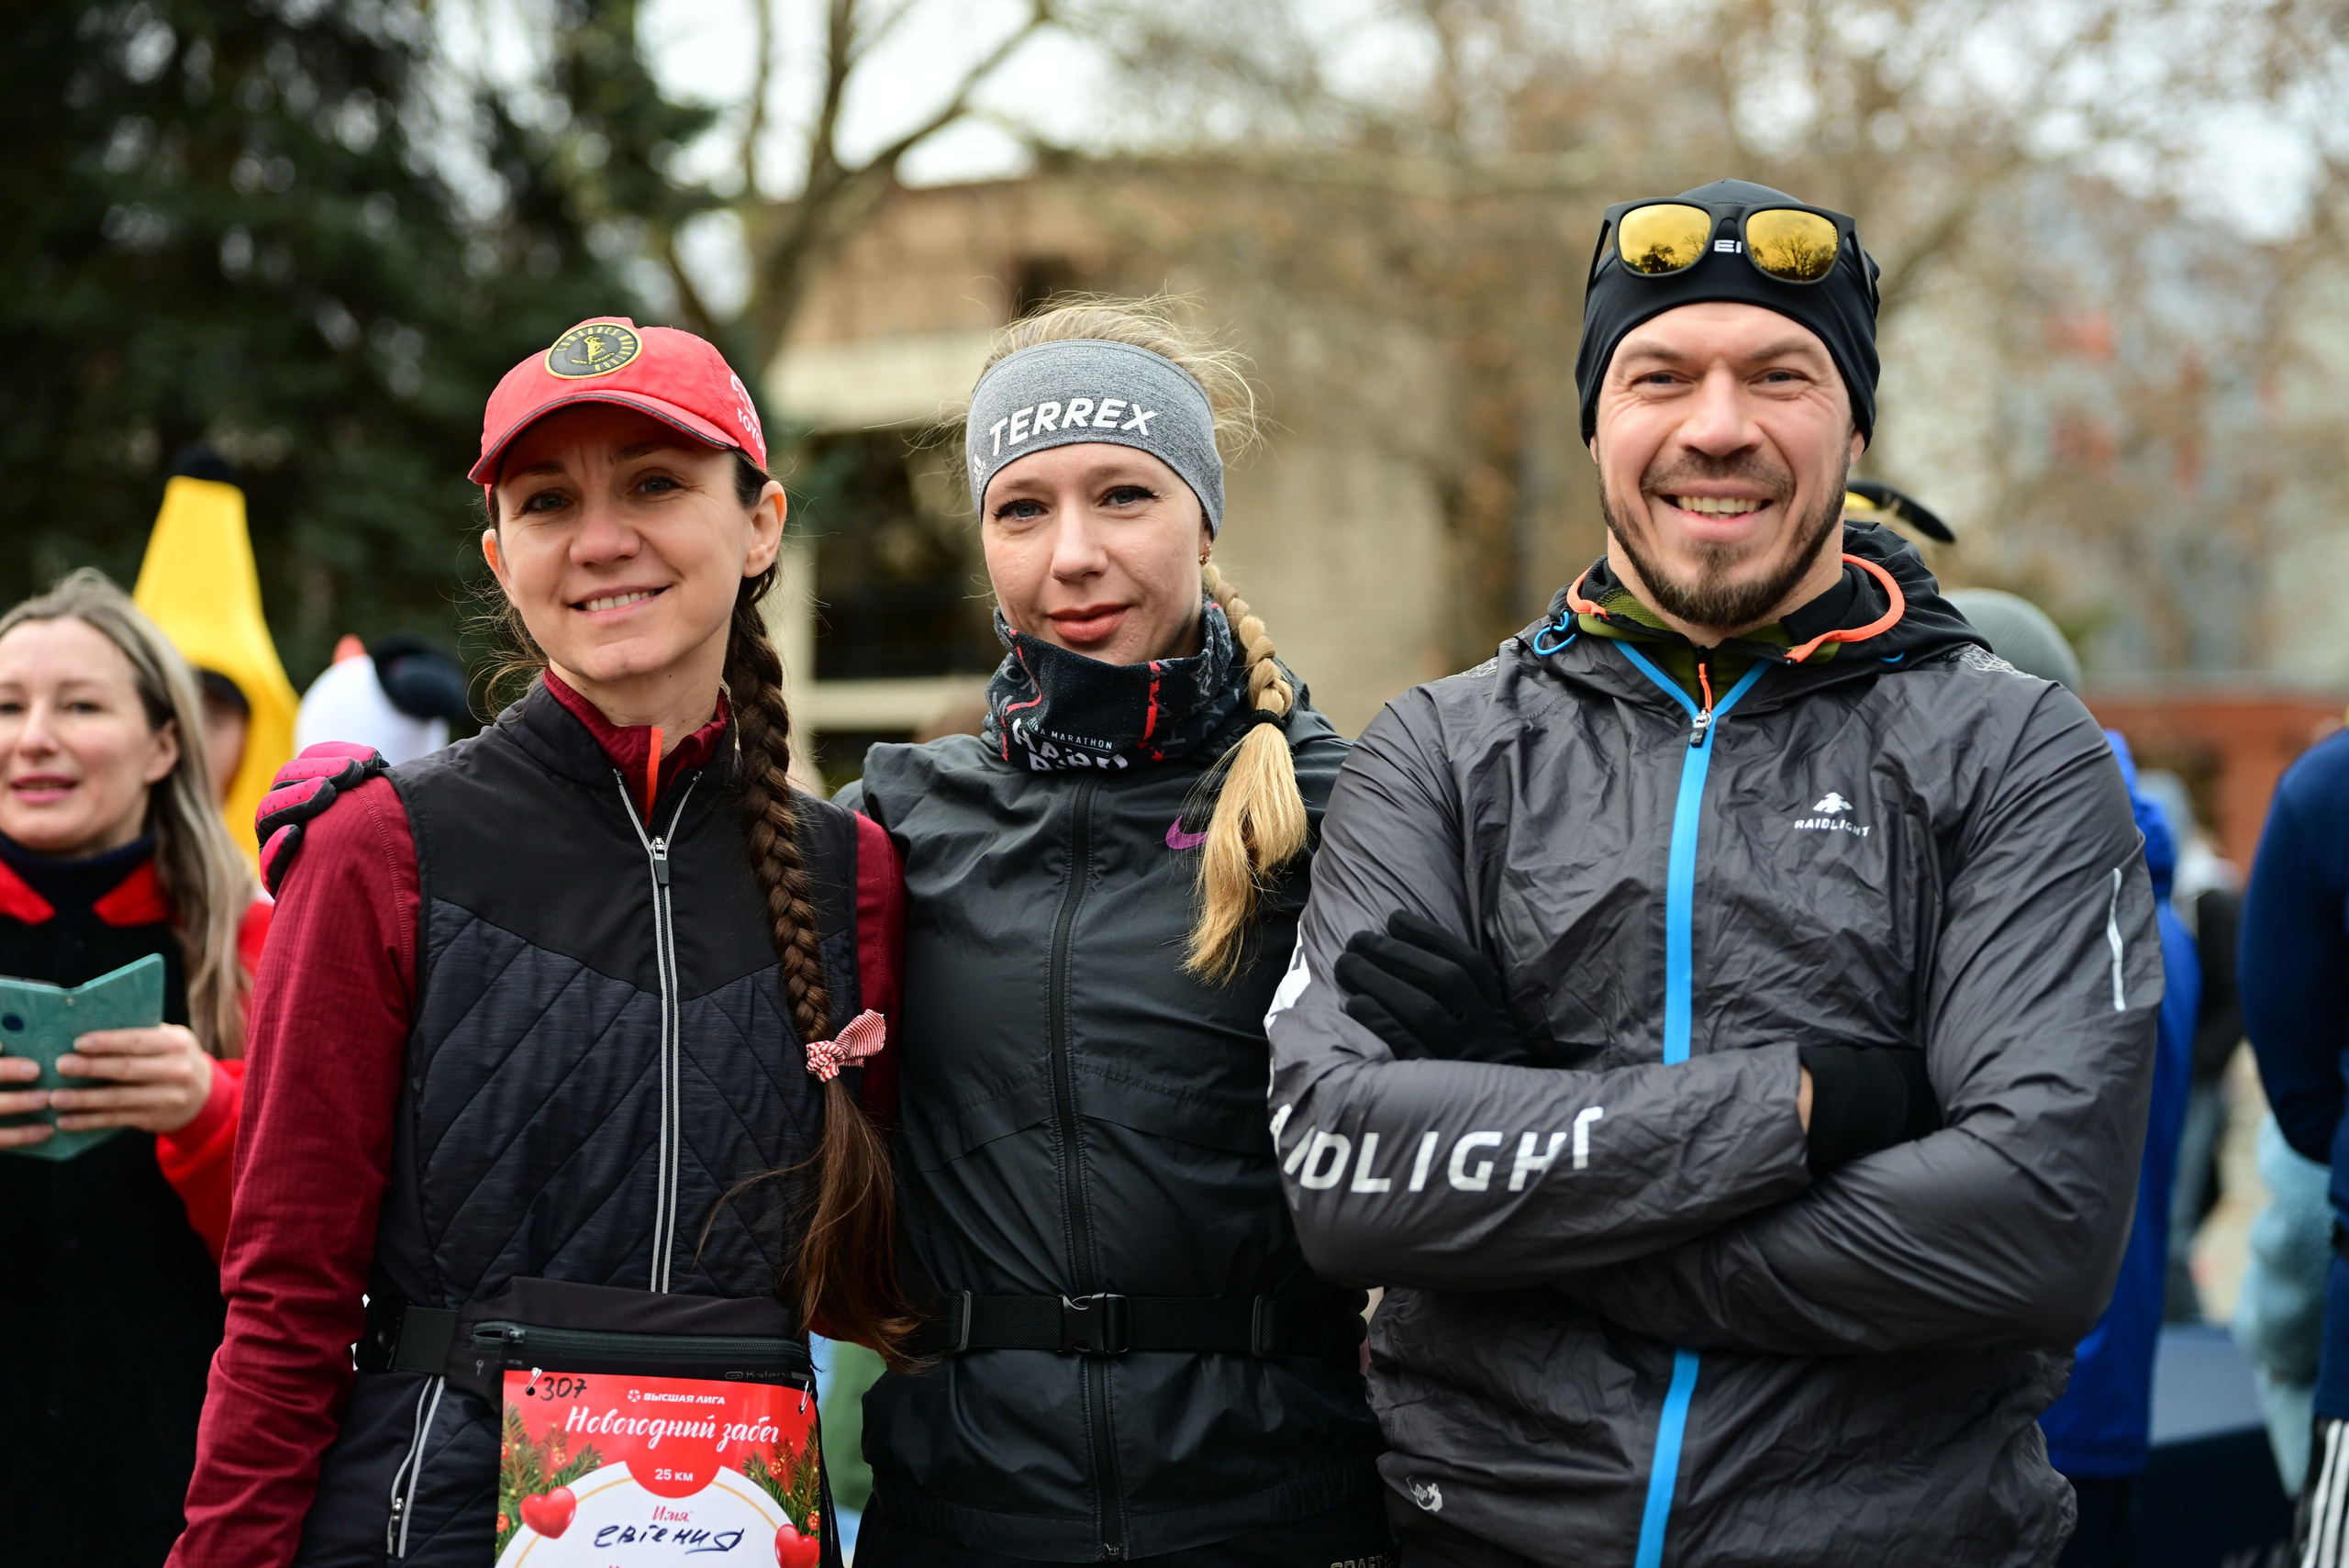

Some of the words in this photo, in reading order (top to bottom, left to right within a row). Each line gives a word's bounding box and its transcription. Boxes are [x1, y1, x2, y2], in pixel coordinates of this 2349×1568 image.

[737, 406, 767, 462] TOYO
[989, 397, 1159, 457] TERREX
[1051, 730, 1113, 751] MARATHON
[1794, 817, 1870, 837] RAIDLIGHT
[1269, 1104, 1604, 1193] IDLIGHT
[540, 1376, 587, 1401] 307
[643, 1393, 695, 1404] ВЫСШАЯ
[696, 1395, 726, 1405] ЛИГА
[564, 1406, 716, 1450] Новогодний
[716, 1416, 779, 1452] забег
[654, 1468, 672, 1481] 25
